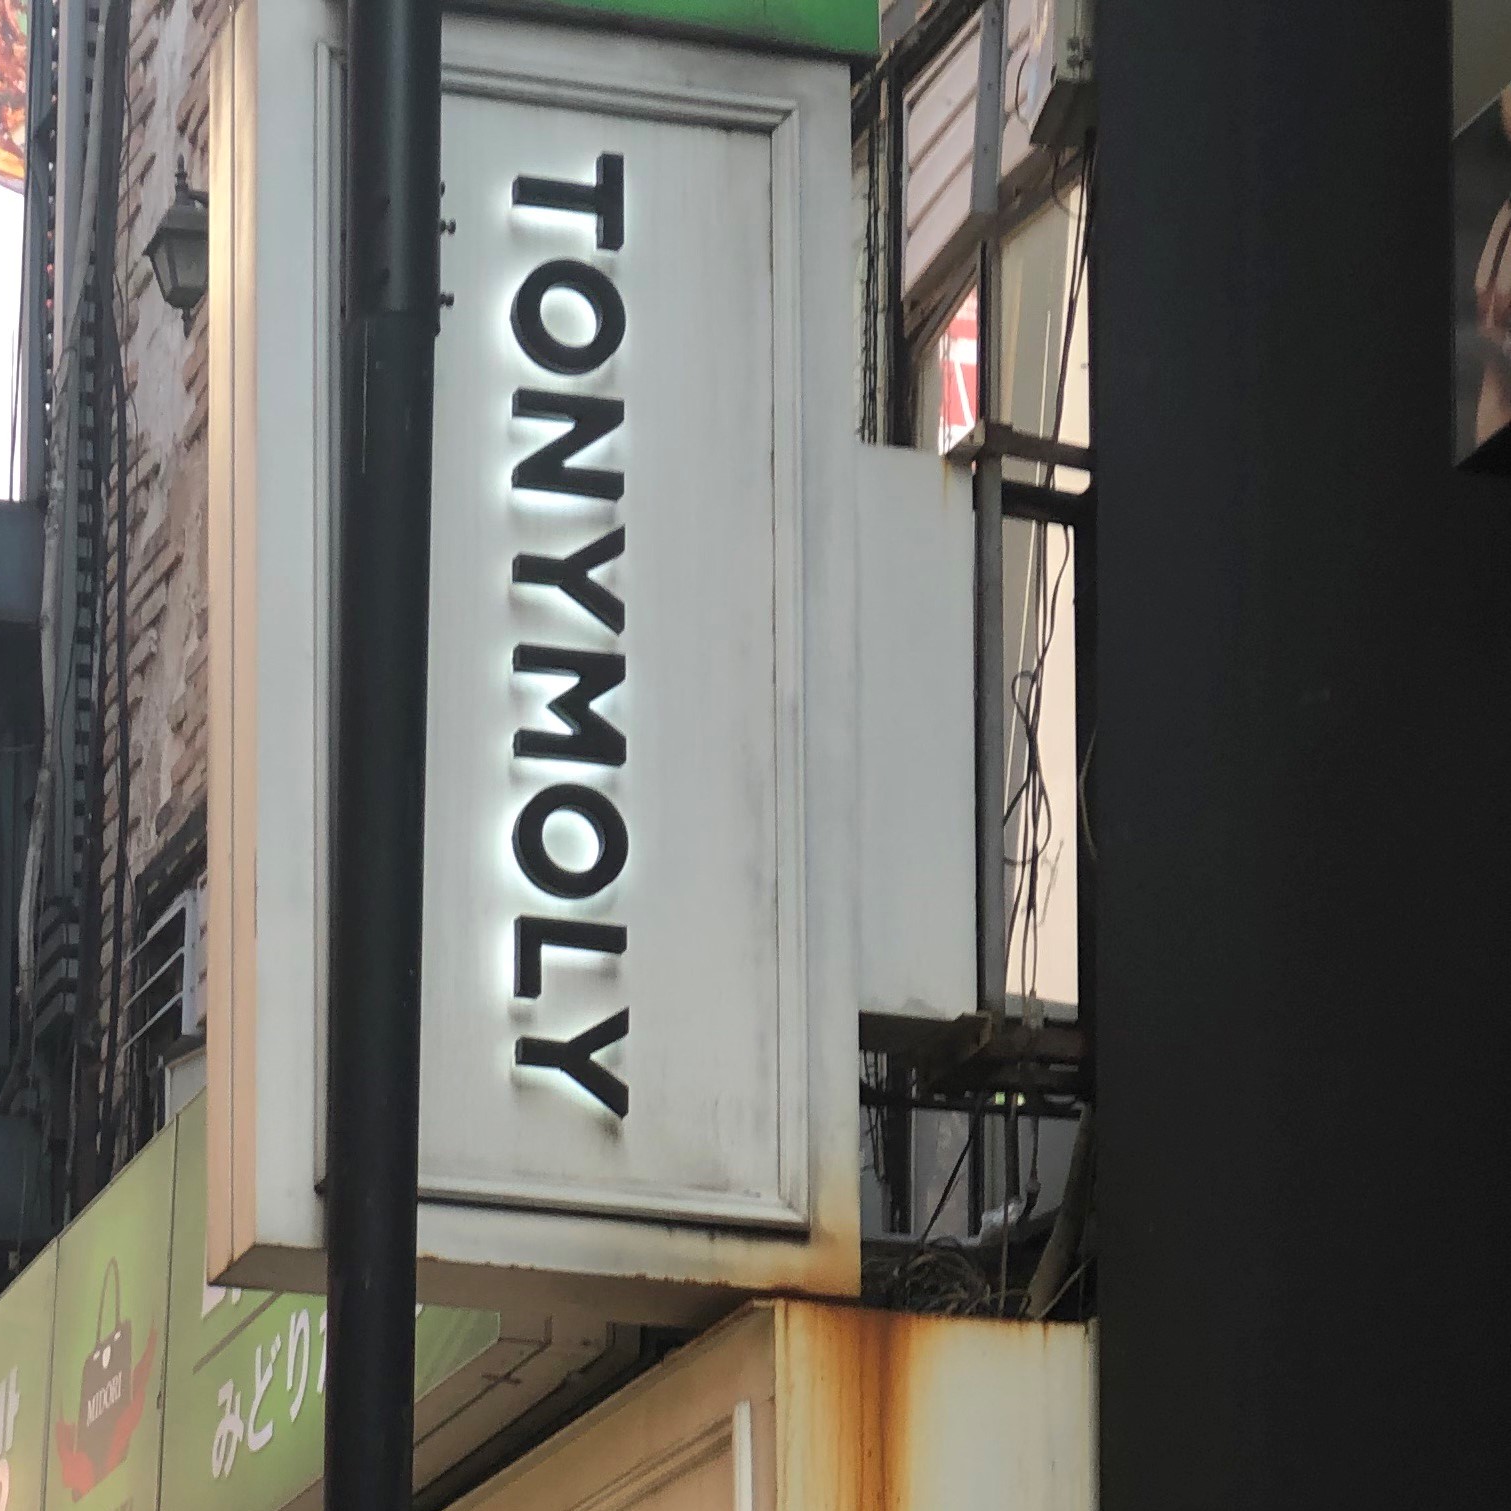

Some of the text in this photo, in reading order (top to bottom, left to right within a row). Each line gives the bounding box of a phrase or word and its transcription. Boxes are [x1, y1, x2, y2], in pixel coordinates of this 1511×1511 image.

[510, 152, 630, 1122] TONYMOLY
[211, 1307, 327, 1479] みどり
